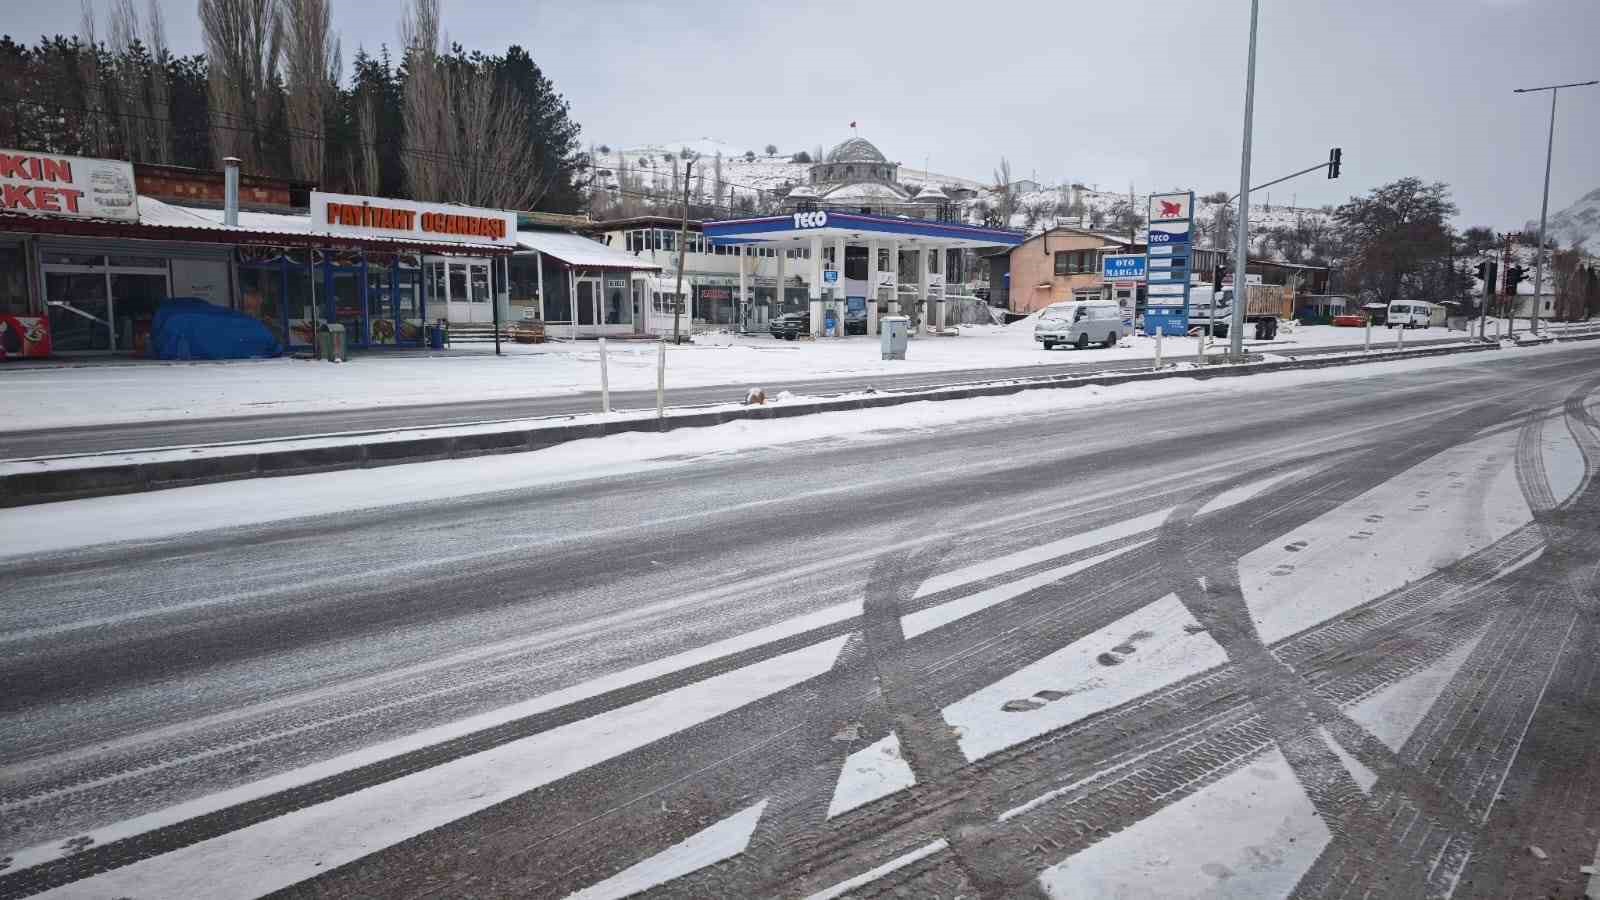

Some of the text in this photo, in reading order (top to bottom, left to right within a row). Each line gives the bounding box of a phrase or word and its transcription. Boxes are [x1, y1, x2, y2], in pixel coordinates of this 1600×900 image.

[0, 184, 84, 213] KET
[793, 210, 827, 228] TECO
[1150, 234, 1170, 242] TECO
[1115, 258, 1134, 266] OTO
